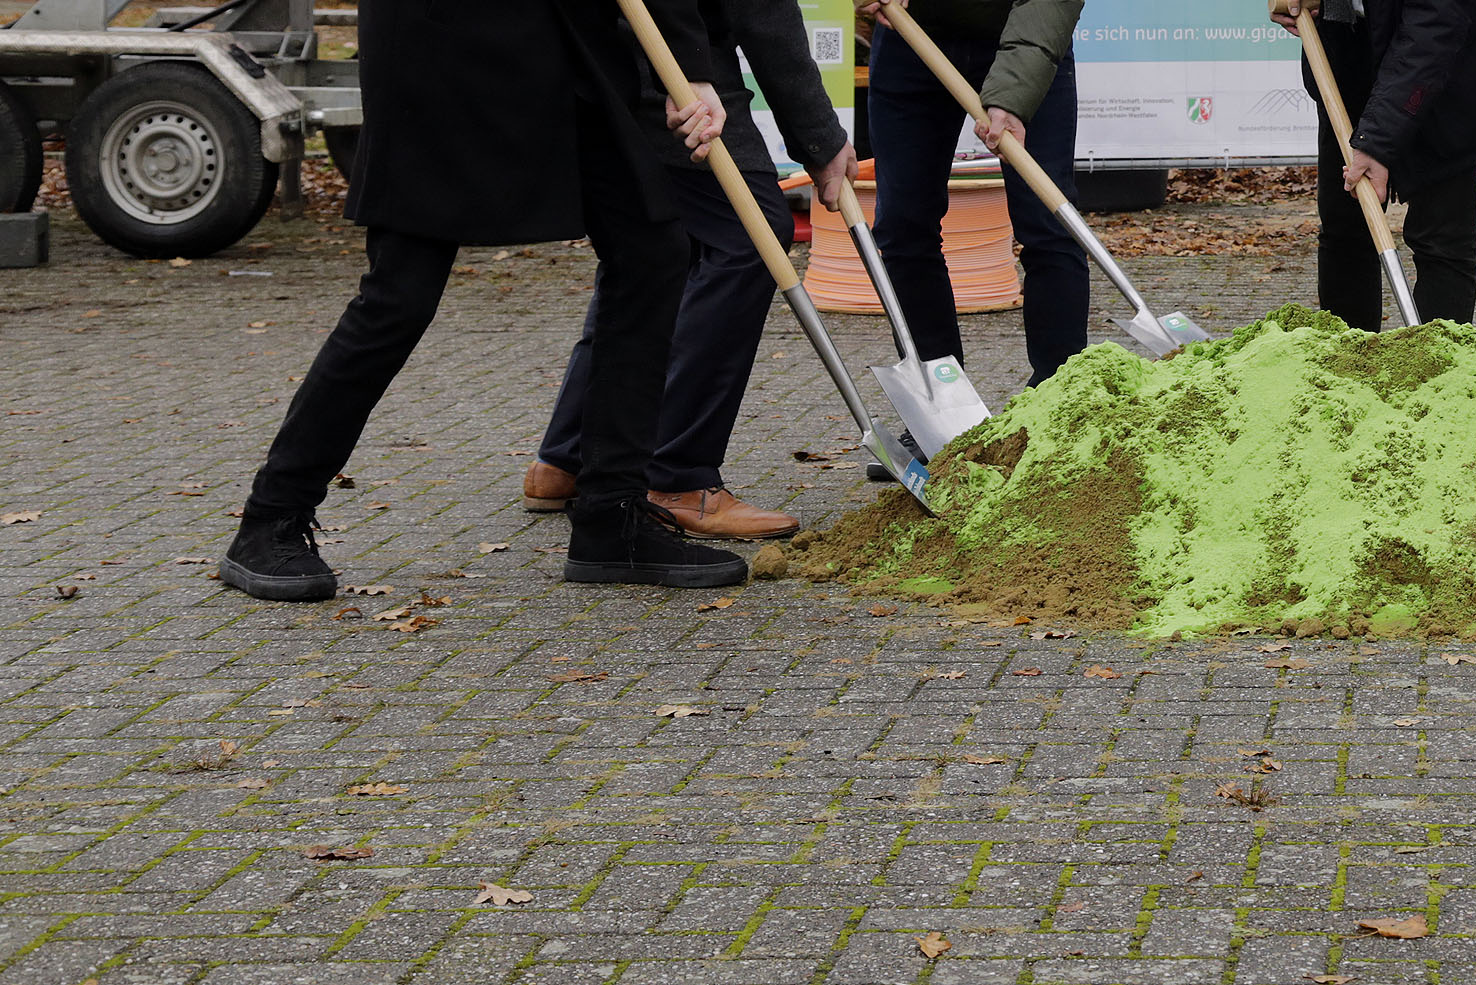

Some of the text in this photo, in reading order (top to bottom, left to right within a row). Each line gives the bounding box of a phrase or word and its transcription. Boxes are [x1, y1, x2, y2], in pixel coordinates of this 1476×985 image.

[1095, 25, 1129, 41] sich
[1135, 28, 1168, 41] nun
[1173, 28, 1200, 41] an:
